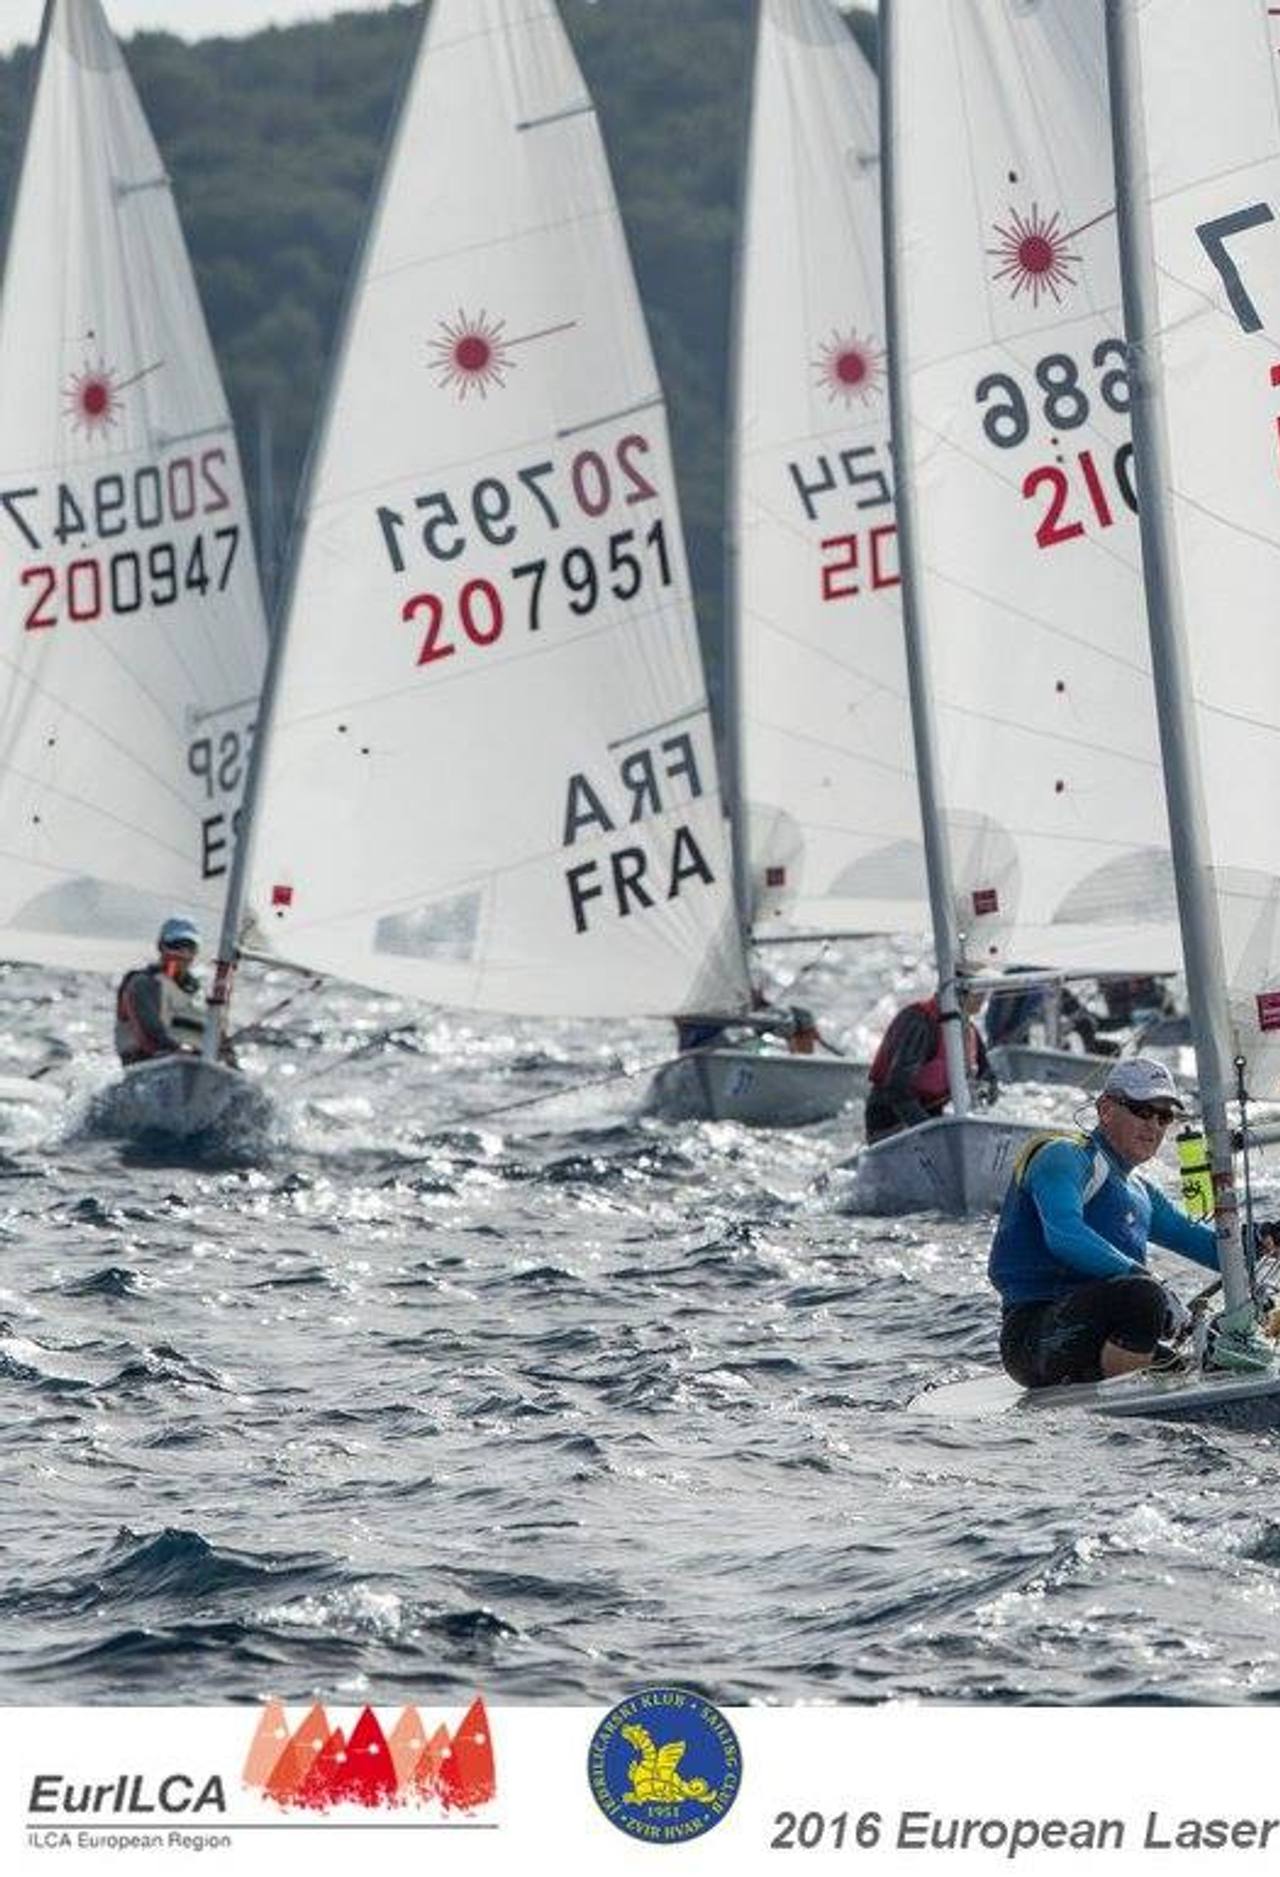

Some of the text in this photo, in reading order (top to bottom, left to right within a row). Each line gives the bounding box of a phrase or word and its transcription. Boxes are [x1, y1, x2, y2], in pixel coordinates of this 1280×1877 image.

[21, 524, 239, 631] 200947
[402, 520, 673, 664] 207951
[566, 826, 715, 932] FRA
